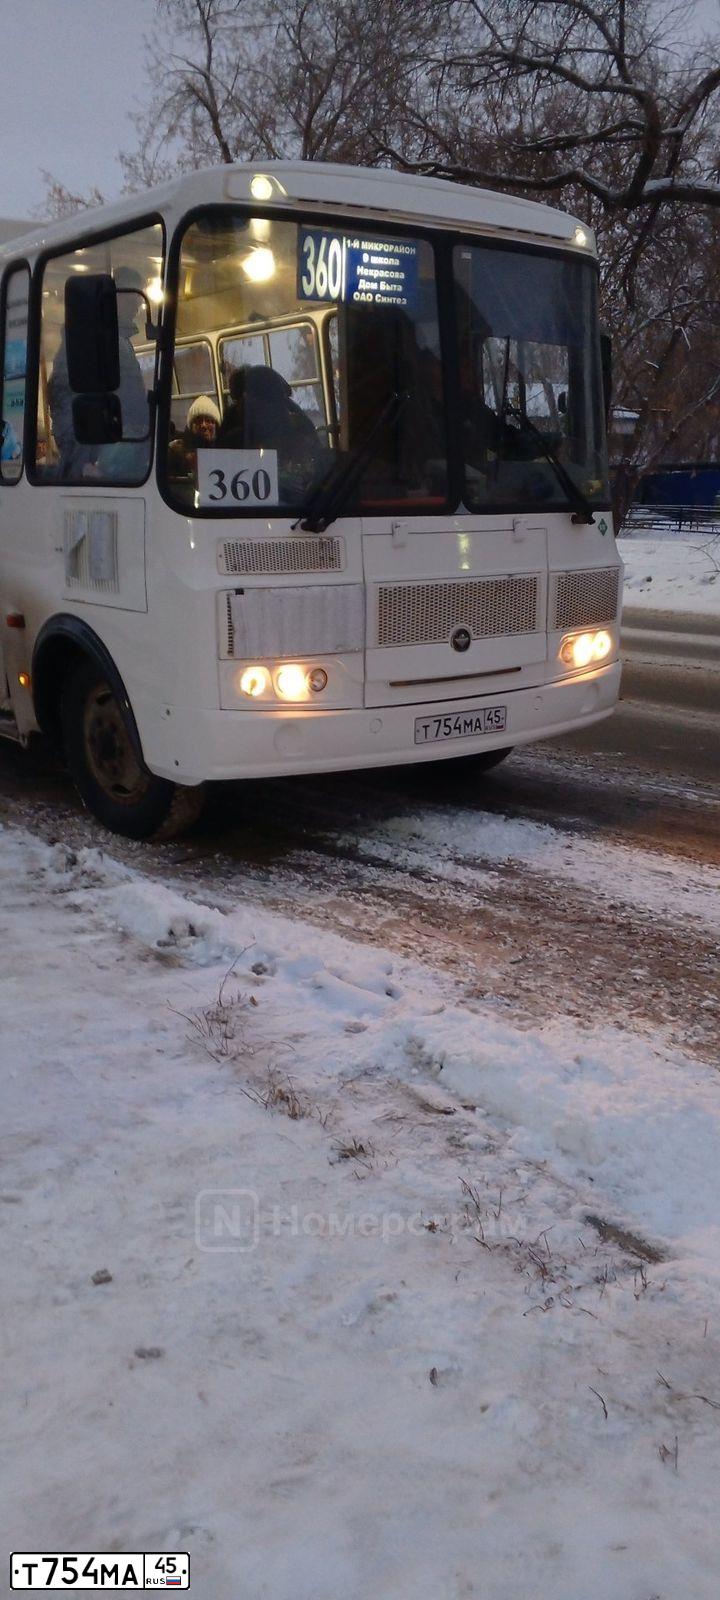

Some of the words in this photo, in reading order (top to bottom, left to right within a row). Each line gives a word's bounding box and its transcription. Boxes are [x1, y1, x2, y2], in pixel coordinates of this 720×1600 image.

[361, 241, 416, 255] МИКРОРАЙОН
[302, 235, 342, 300] 360
[371, 255, 400, 266] школа
[356, 265, 405, 280] Некрасова
[358, 279, 378, 291] Дом
[380, 281, 403, 292] Быта
[353, 291, 374, 302] ОАО
[375, 293, 408, 305] Синтез
[209, 469, 271, 501] 360
[486, 710, 501, 724] 45
[422, 716, 482, 739] Т754МА
